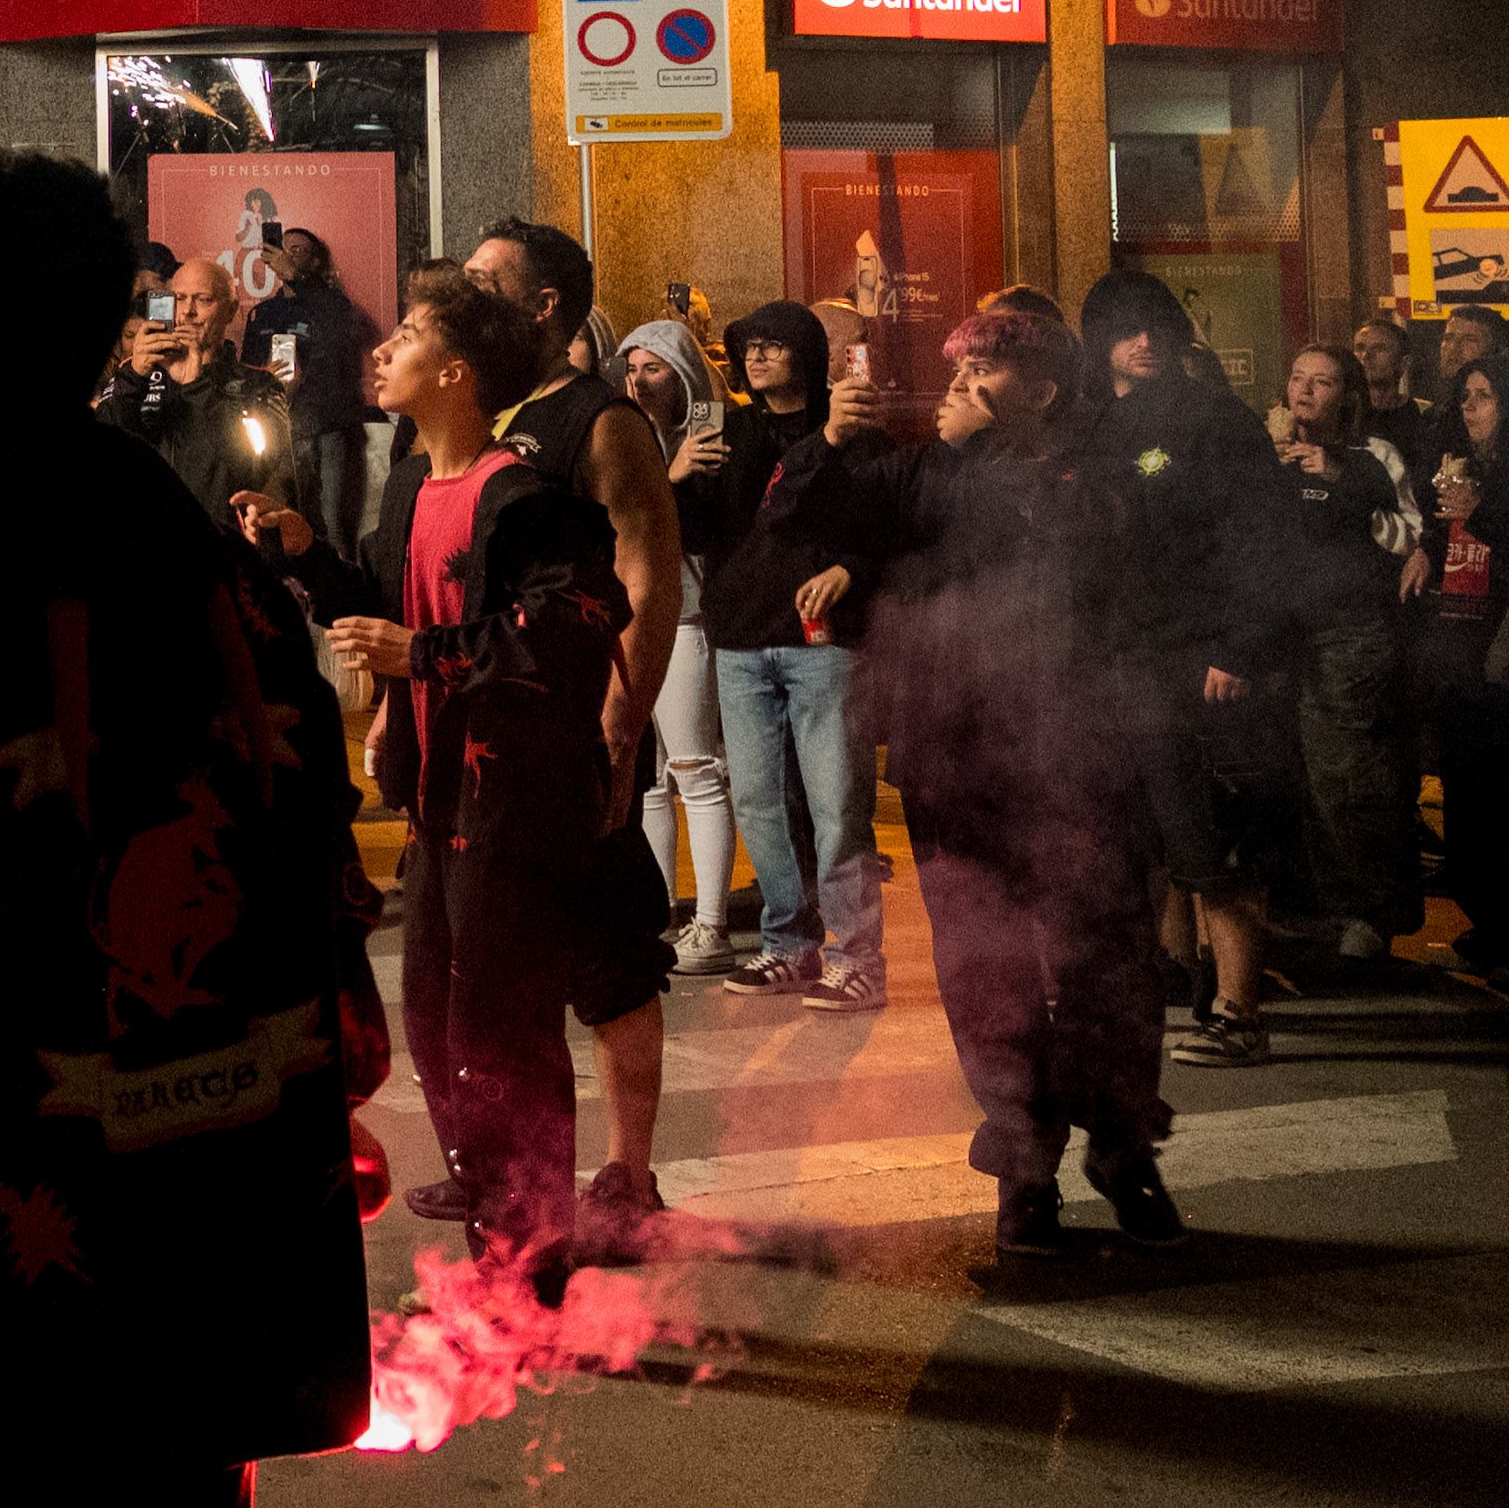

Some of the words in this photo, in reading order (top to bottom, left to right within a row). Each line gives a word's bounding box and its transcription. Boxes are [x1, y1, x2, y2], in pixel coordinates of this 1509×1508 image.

[615, 118, 647, 129] Control
[651, 118, 662, 128] de
[209, 164, 331, 177] BIENESTANDO
[845, 184, 930, 197] BIENESTANDO
